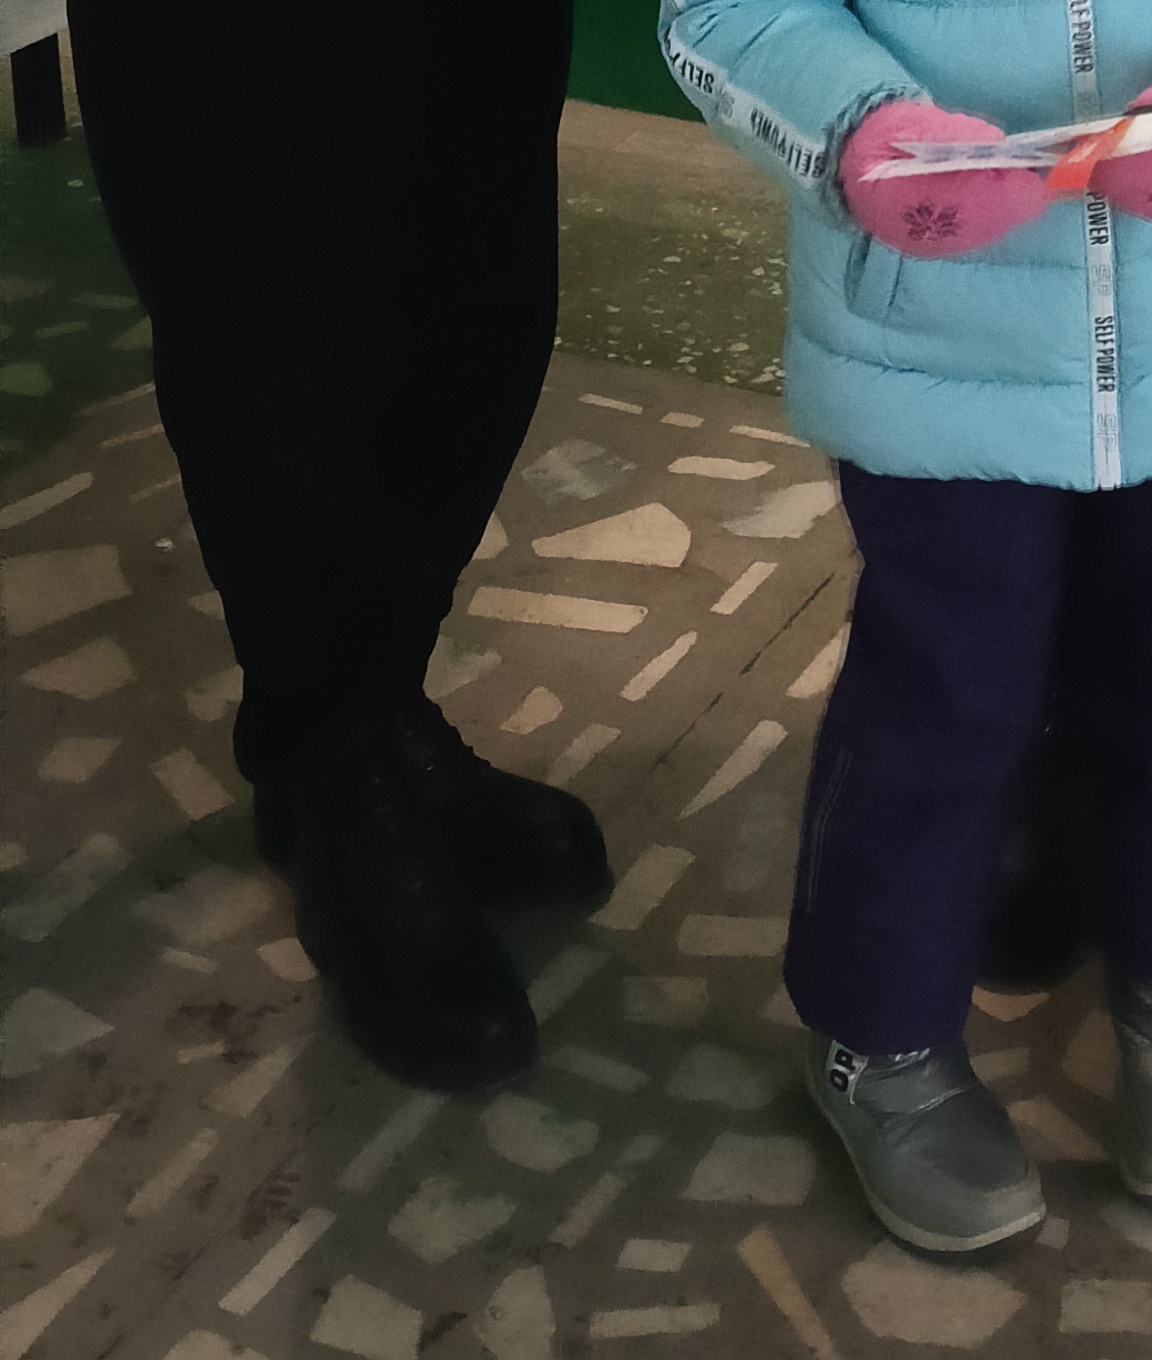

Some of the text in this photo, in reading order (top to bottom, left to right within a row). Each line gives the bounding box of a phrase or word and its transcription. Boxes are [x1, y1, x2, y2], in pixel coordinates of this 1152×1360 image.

[1071, 20, 1095, 75] POWER
[1085, 190, 1110, 246] POWER
[1094, 316, 1116, 393] SELF POWER
